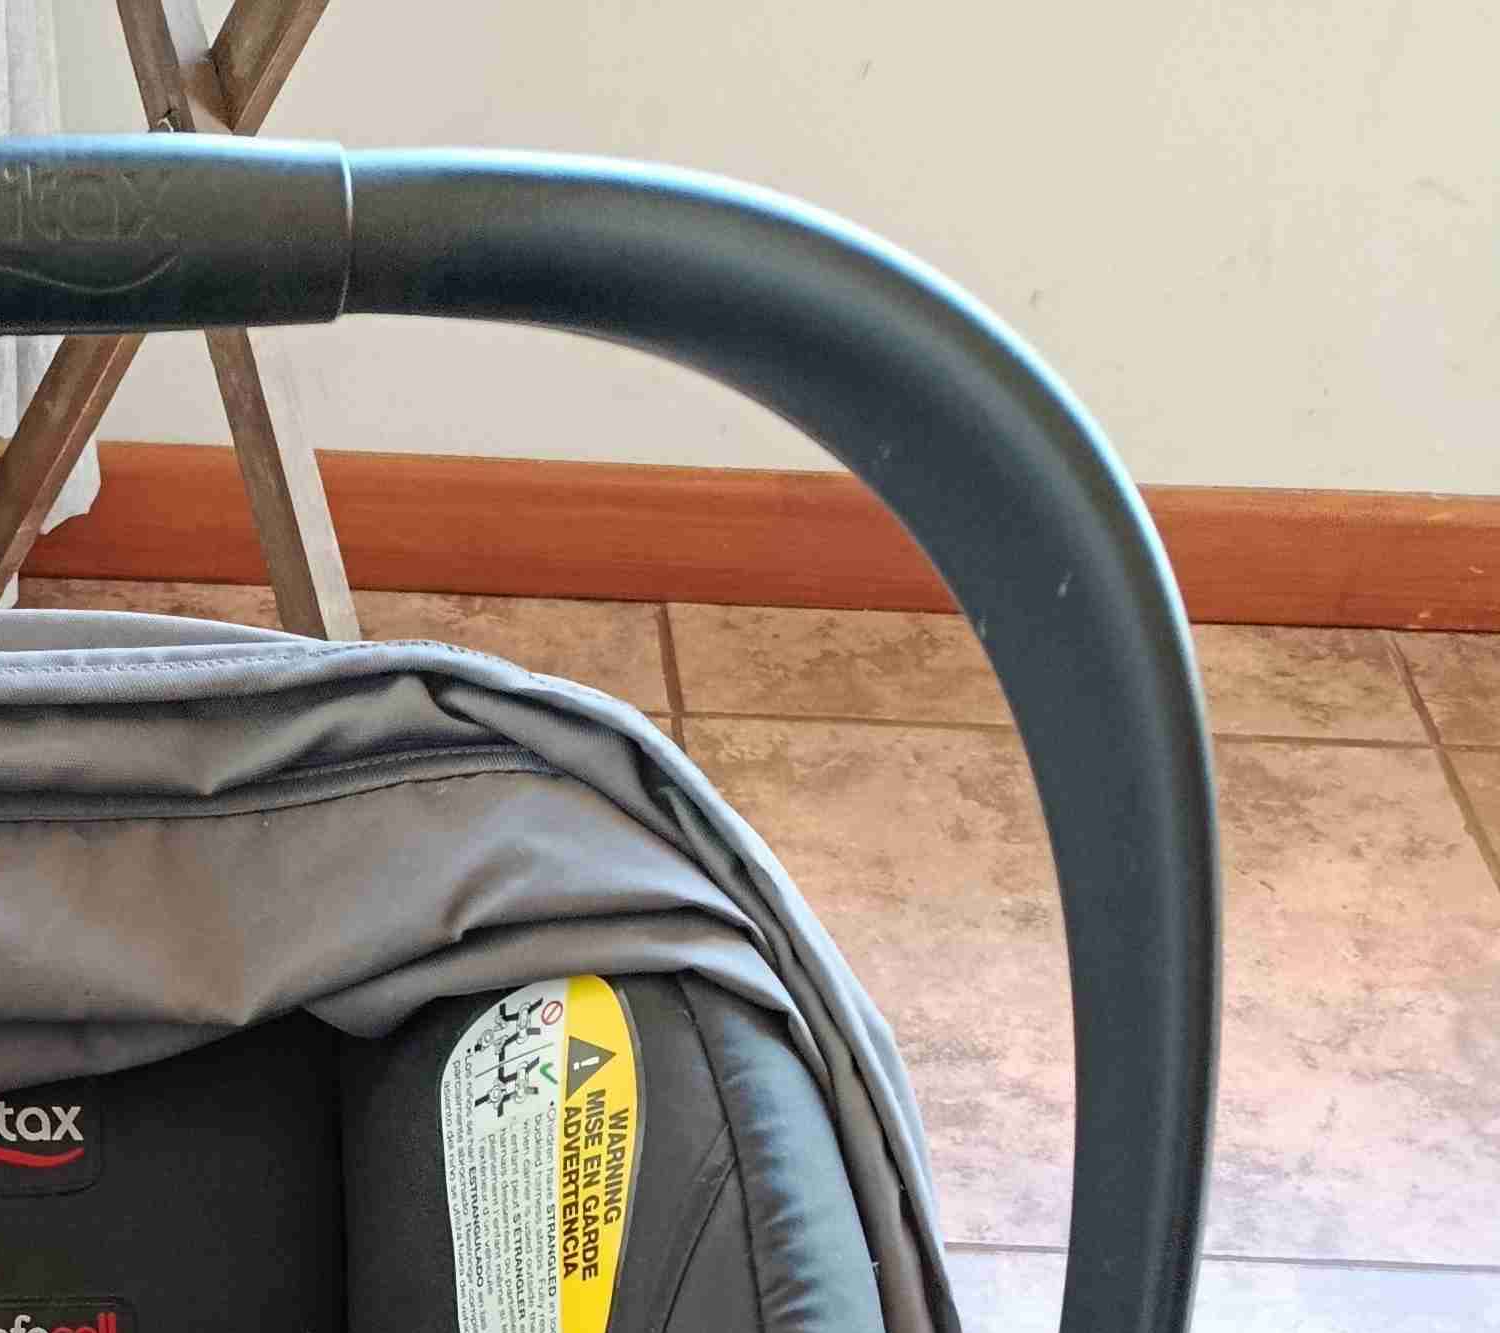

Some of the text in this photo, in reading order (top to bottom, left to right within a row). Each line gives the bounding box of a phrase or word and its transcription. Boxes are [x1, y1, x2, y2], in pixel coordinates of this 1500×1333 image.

[563, 1106, 582, 1280] ADVERTENCIA
[582, 1089, 606, 1280] MISE EN GARDE
[604, 1109, 629, 1225] WARNING
[547, 1204, 557, 1296] STRANGLED
